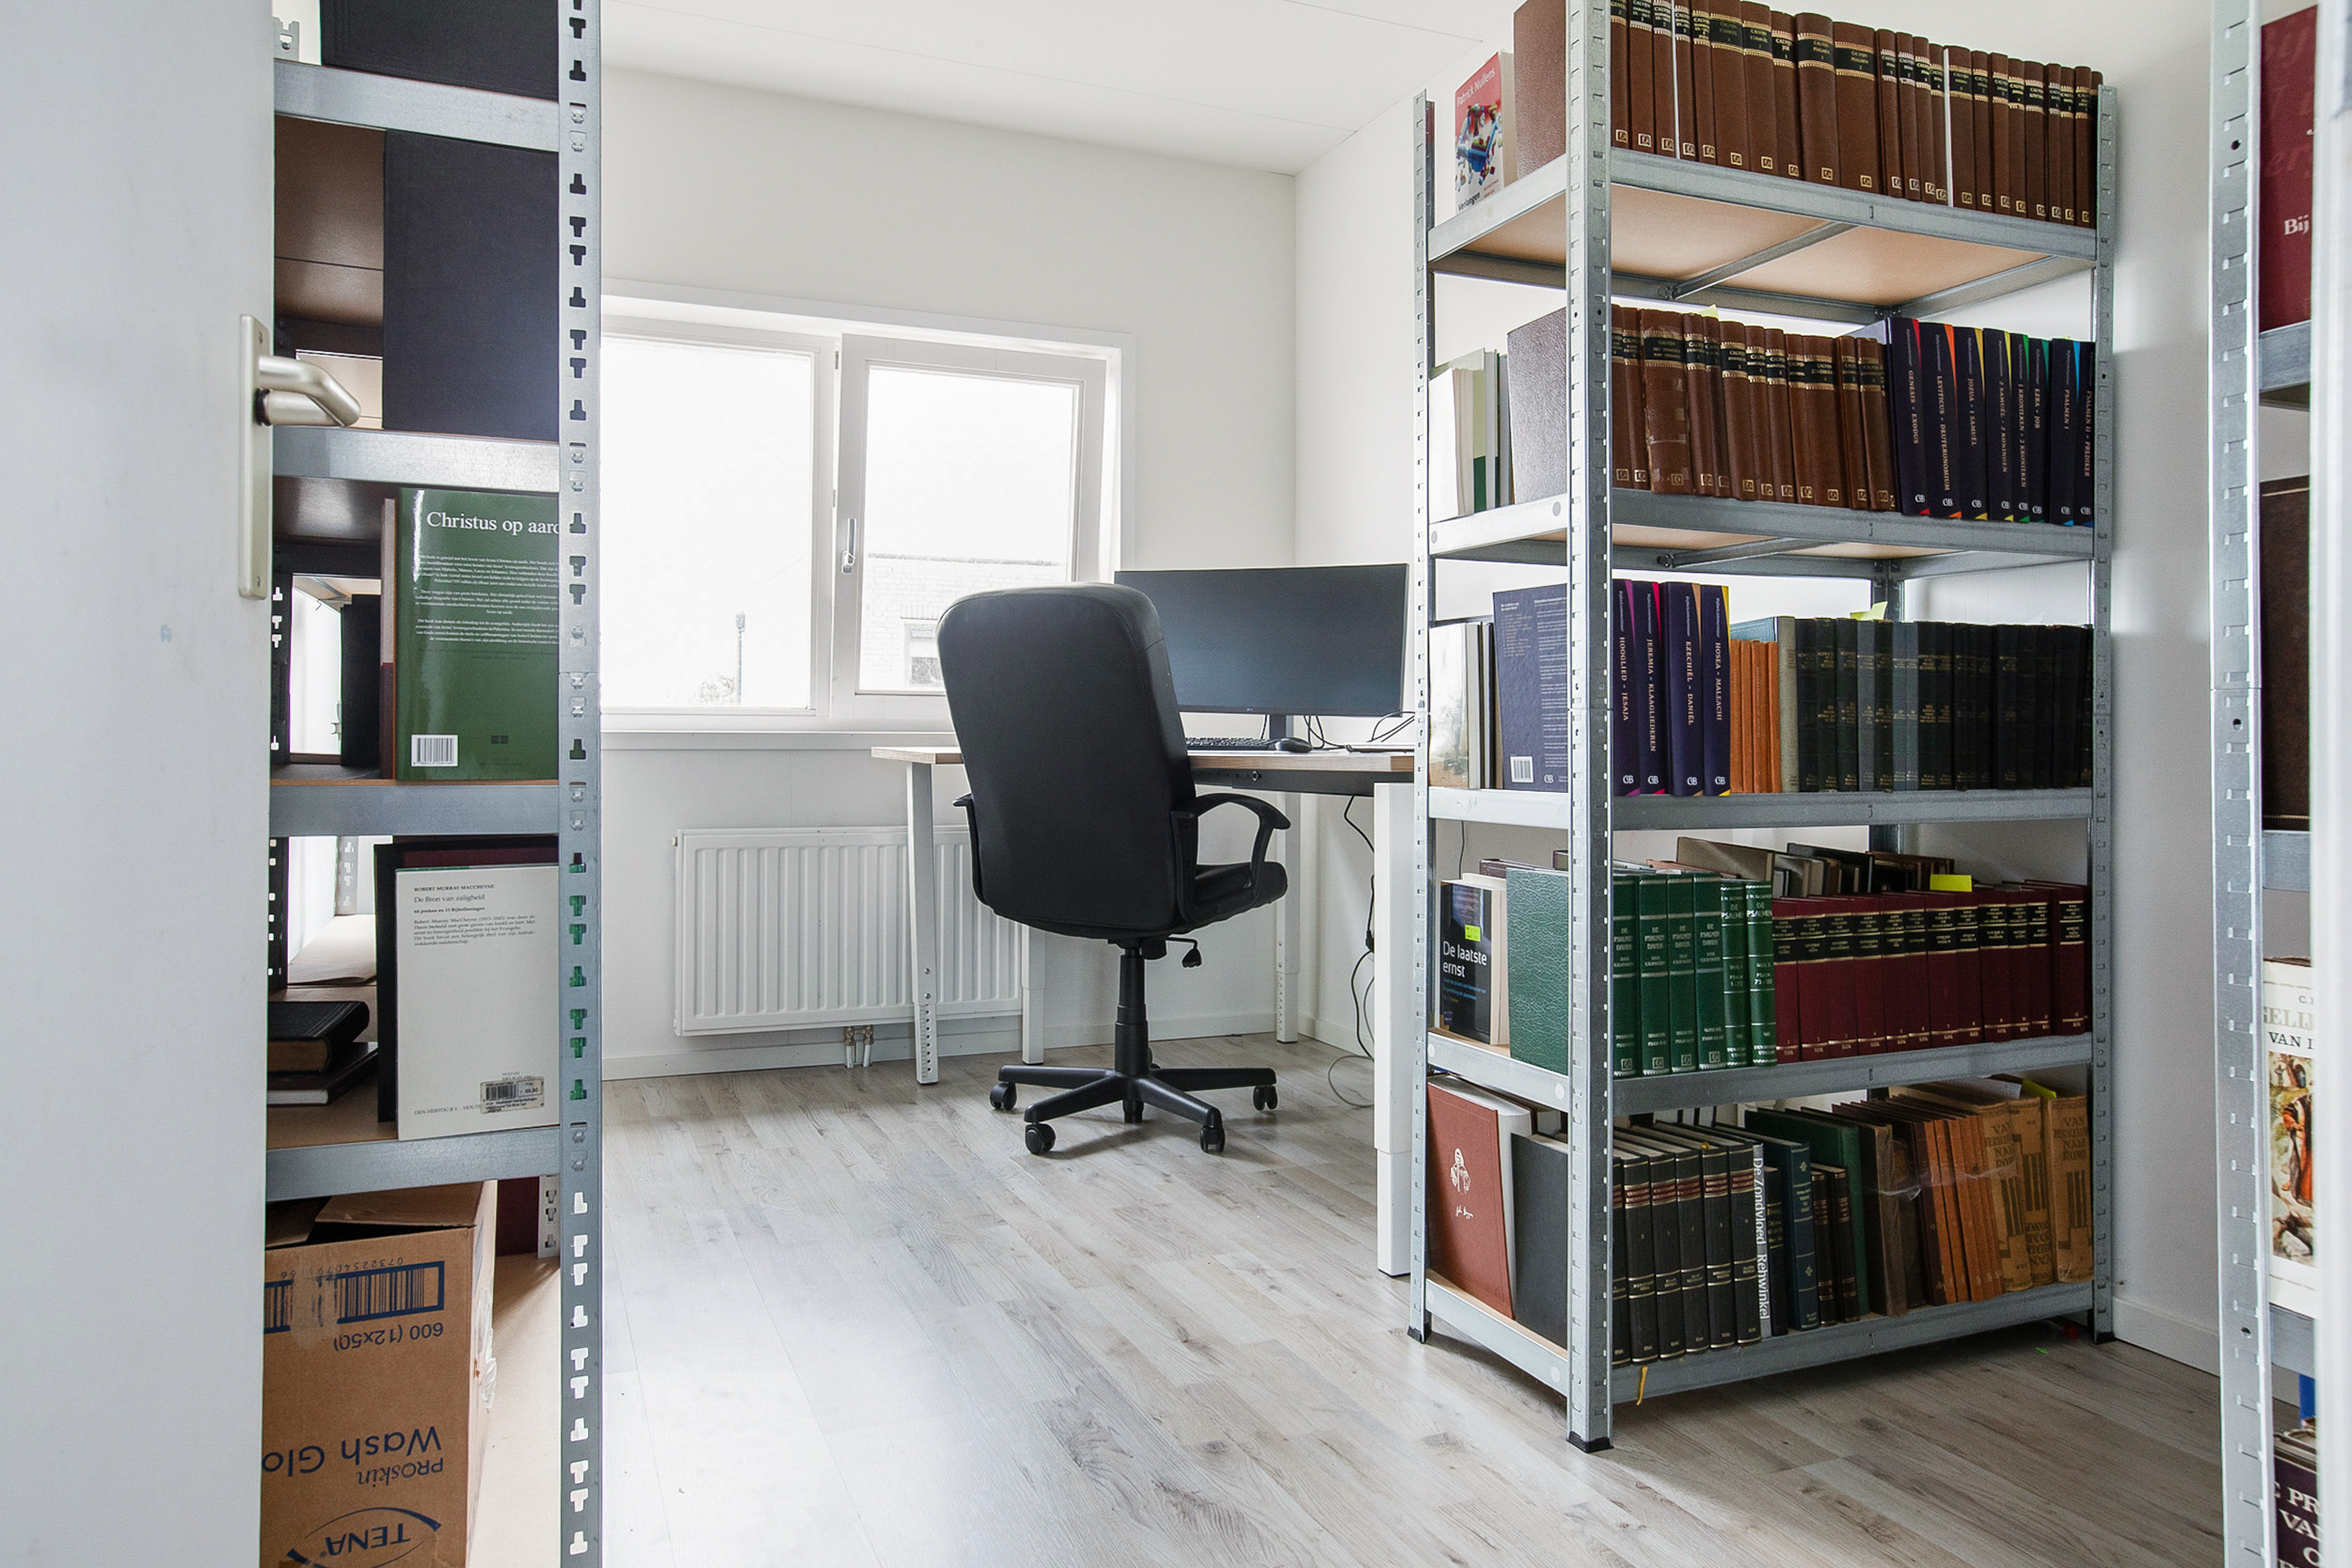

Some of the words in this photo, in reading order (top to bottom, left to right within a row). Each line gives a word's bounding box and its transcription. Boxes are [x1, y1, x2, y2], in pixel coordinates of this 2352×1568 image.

[1456, 86, 1474, 107] Patrick
[1474, 68, 1496, 92] Nullens
[2283, 214, 2310, 236] Bij
[1940, 423, 1949, 491] DEUTERONOMIUM
[426, 512, 497, 531] Christus
[502, 520, 523, 536] op
[1619, 637, 1628, 681] HOOGLIED
[1685, 641, 1693, 682] EZECHIËL
[1648, 683, 1657, 752] KLAAGLIEDEREN
[455, 894, 485, 902] zaligheid
[1746, 910, 1772, 918] PSALMEN
[1443, 941, 1455, 957] De
[1457, 943, 1487, 966] laatste
[1443, 961, 1466, 977] ernst
[2267, 1031, 2301, 1048] VAN
[1753, 1157, 1764, 1176] De
[1754, 1179, 1767, 1244] Zondvloed
[1756, 1255, 1770, 1320] Rehwinkel
[333, 1324, 404, 1352] (12x50)
[409, 1322, 444, 1341] 600
[342, 1426, 442, 1465] Wash
[357, 1458, 444, 1488] PROskin
[325, 1523, 411, 1557] TENA
